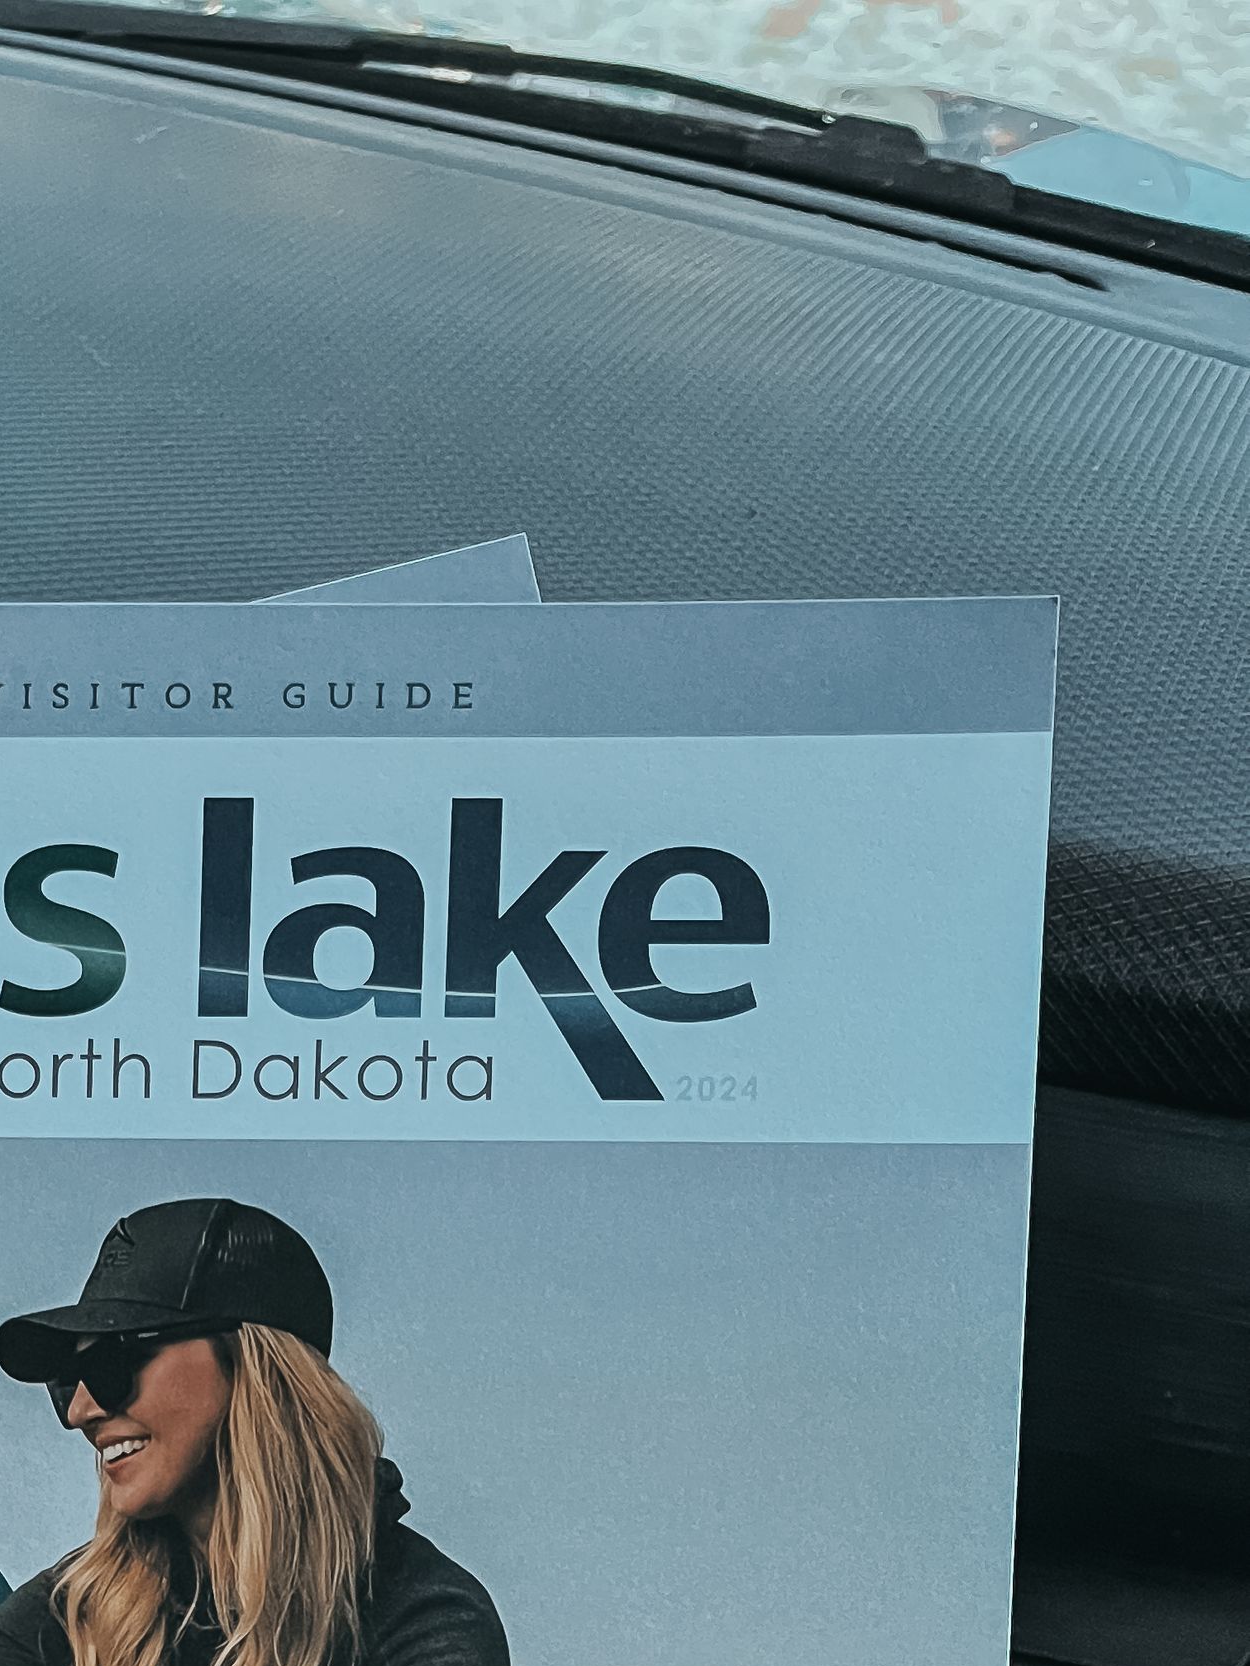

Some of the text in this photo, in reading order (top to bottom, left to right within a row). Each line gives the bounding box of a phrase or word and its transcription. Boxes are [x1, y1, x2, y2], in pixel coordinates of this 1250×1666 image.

[281, 682, 475, 711] GUIDE
[196, 797, 772, 1103] lake
[191, 1039, 494, 1103] Dakota
[674, 1075, 759, 1102] 2024
